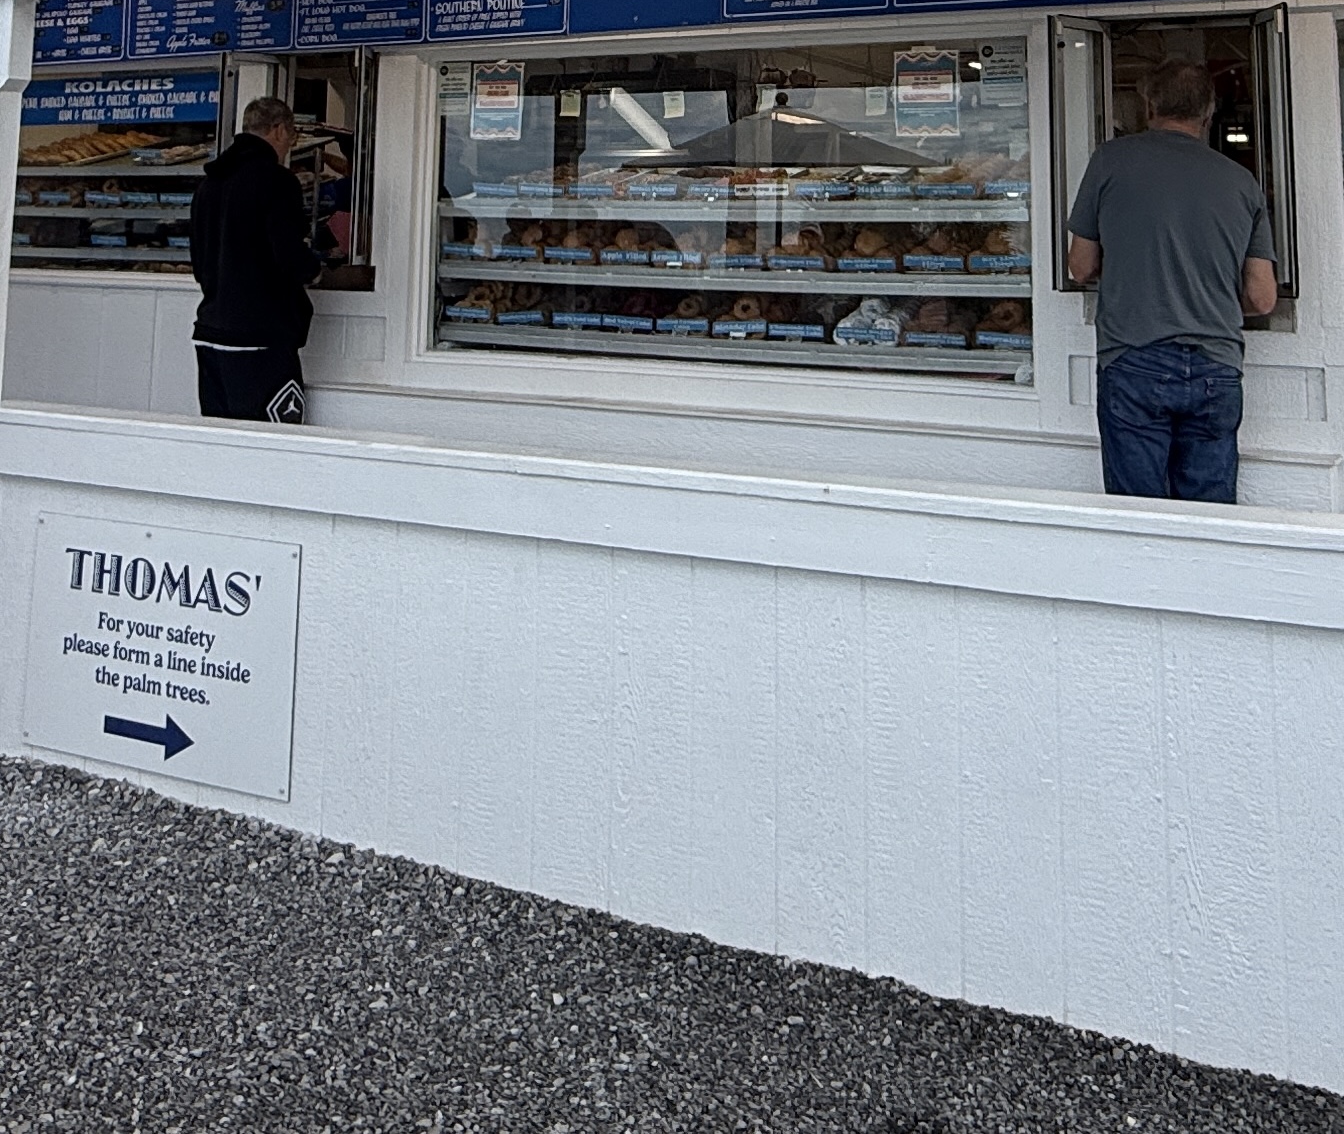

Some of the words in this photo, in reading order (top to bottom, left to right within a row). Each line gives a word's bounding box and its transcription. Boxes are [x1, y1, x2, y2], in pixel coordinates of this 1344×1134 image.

[435, 0, 483, 15] SOUTHERN
[65, 77, 174, 94] KOLACHES
[66, 548, 261, 616] THOMAS'
[98, 612, 123, 632] For
[126, 620, 163, 640] your
[166, 625, 215, 654] safety
[63, 633, 109, 658] please
[113, 640, 150, 665] form
[154, 654, 162, 667] a
[167, 651, 196, 673] line
[200, 656, 250, 683] inside
[95, 666, 119, 686] the
[123, 673, 161, 696] palm
[166, 680, 209, 705] trees.
